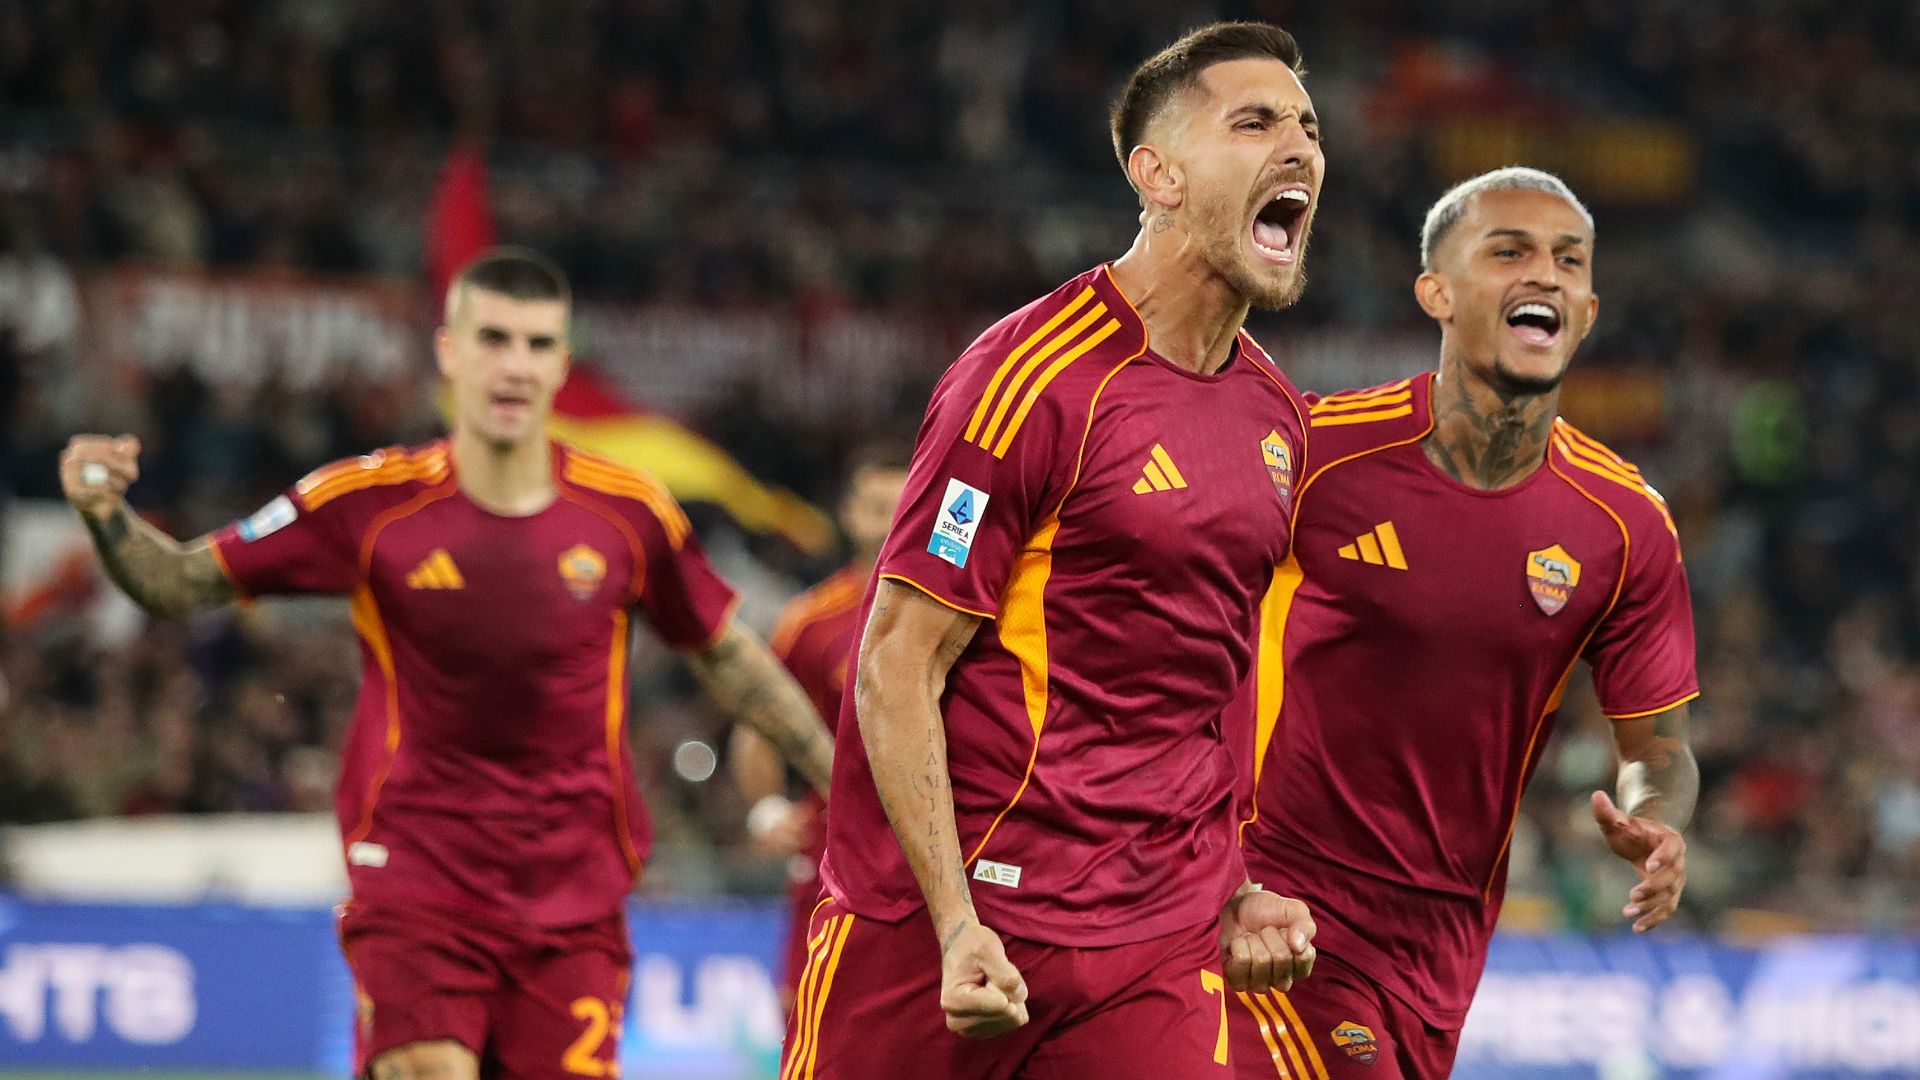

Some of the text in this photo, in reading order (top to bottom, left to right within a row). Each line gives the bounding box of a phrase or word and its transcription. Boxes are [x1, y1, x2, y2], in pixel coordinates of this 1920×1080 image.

[942, 521, 964, 536] SERIE
[1531, 581, 1568, 601] ROMA
[1200, 968, 1228, 1066] 7
[1345, 1044, 1378, 1056] ROMA
